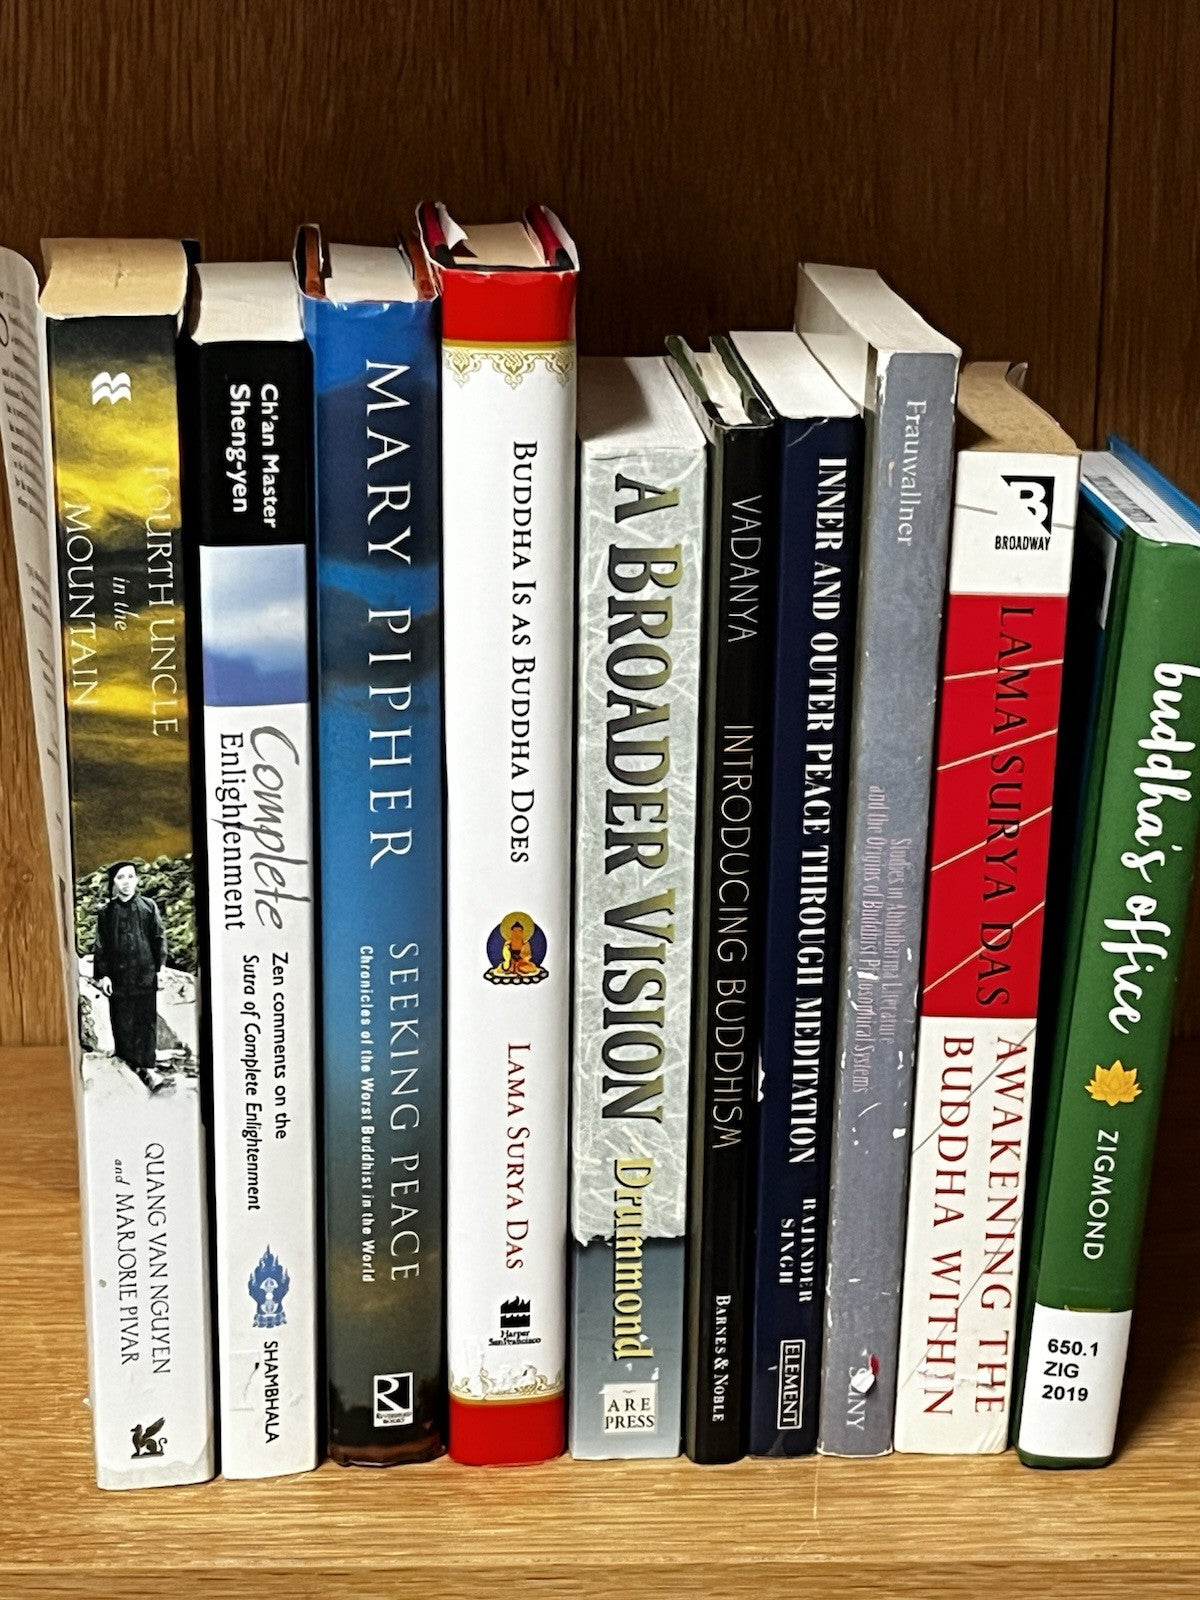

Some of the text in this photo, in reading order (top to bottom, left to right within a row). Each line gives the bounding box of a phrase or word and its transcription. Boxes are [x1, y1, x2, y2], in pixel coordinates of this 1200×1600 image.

[225, 383, 252, 513] Sheng-yen
[260, 383, 281, 529] Ch'an Master
[512, 441, 538, 571] BUDDHA
[897, 400, 927, 547] Frauwallner
[64, 501, 99, 707] MOUNTAIN
[112, 576, 140, 632] in the
[144, 467, 179, 737] FOURTH UNCLE
[727, 494, 763, 643] VADANYA
[994, 535, 1051, 551] BROADWAY
[365, 357, 413, 871] MARY PIPHER
[511, 656, 536, 780] BUDDHA
[211, 725, 312, 930] Complete
[215, 732, 248, 931] Enlightenment
[510, 789, 535, 865] DOES
[601, 473, 683, 1124] A BROADER VISION
[788, 457, 848, 1164] INNER AND OUTER PEACE THROUGH MEDITATION
[862, 837, 888, 882] Origins
[866, 813, 889, 833] the
[867, 785, 889, 810] and
[888, 838, 912, 885] Studies
[975, 605, 1035, 1007] LAMA SURYA DAS
[1100, 661, 1200, 1035] buddha's office
[712, 725, 755, 1149] INTRODUCING BUDDHISM
[859, 901, 884, 955] Buddhist
[862, 885, 885, 897] of
[887, 887, 903, 899] in
[271, 952, 291, 1140] Zen comments on the
[852, 1045, 875, 1093] Systems
[878, 983, 903, 1045] Literature
[240, 954, 262, 1211] Sutra of Complete Enlightenment
[359, 945, 376, 1284] Chronicles of the Worst Buddhist in the World
[389, 942, 420, 1282] SEEKING PEACE
[933, 1035, 975, 1228] BUDDHA
[506, 1042, 531, 1270] LAMA SURYA DAS
[1083, 1129, 1120, 1261] ZIGMOND
[114, 1158, 140, 1366] and MARJORIE PIVAR
[144, 1142, 171, 1375] QUANG VAN NGUYEN
[613, 1157, 655, 1362] Drummond
[779, 1217, 796, 1284] SINGH
[798, 1198, 817, 1302] RAJINDER
[974, 1034, 1028, 1414] AWAKENING THE
[263, 1340, 281, 1445] SHAMBHALA
[712, 1295, 732, 1422] BARNES & NOBLE
[782, 1343, 801, 1426] ELEMENT
[1041, 1384, 1089, 1402] 2019
[1043, 1361, 1080, 1379] ZIG
[1047, 1338, 1099, 1357] 650.1
[605, 1414, 655, 1430] PRESS
